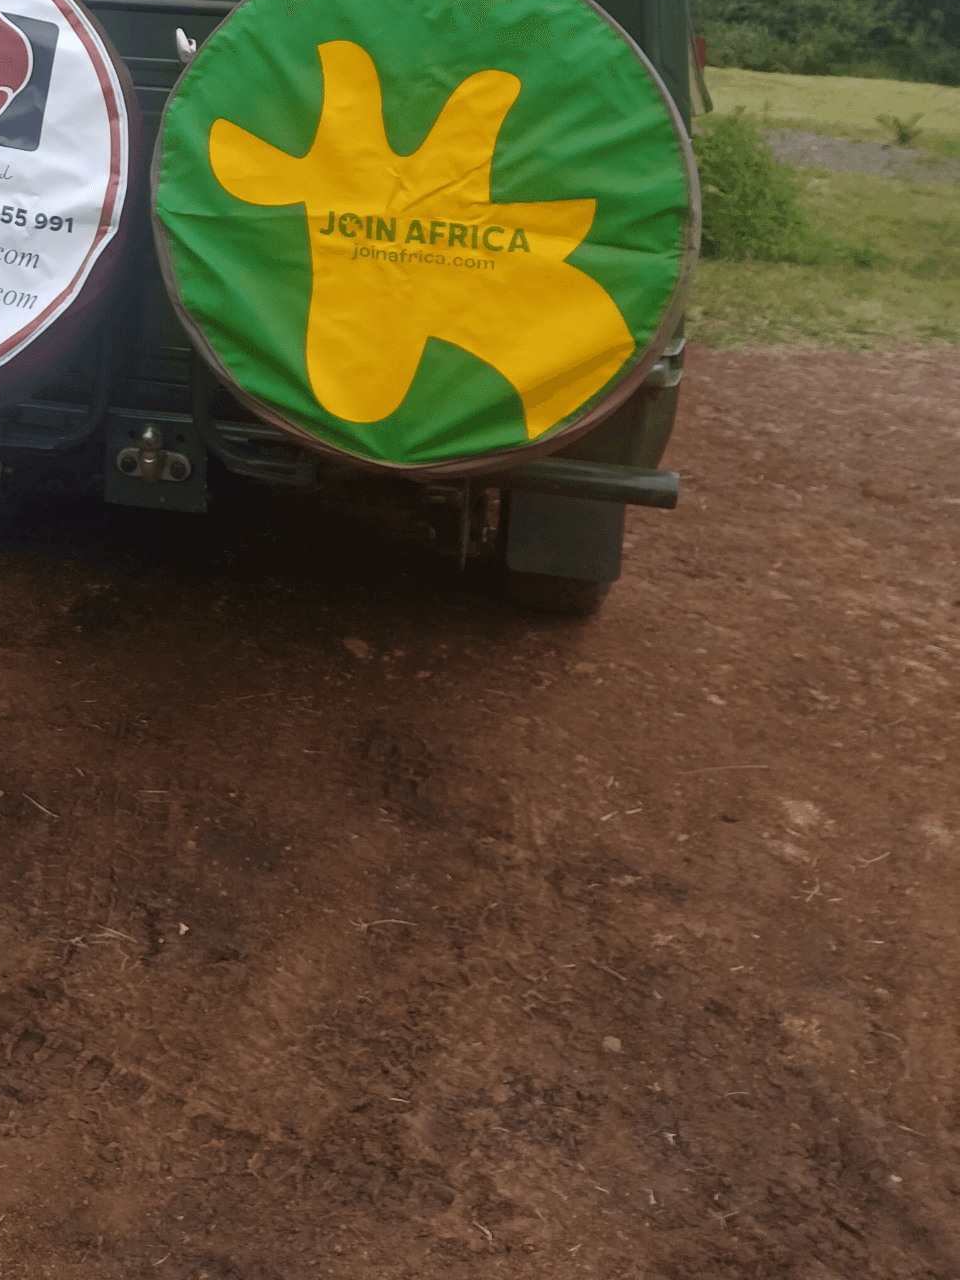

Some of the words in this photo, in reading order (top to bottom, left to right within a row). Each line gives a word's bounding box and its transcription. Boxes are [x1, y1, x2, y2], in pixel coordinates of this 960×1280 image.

[34, 212, 74, 234] 991
[319, 210, 397, 243] JOIN
[404, 219, 531, 253] AFRICA
[351, 243, 495, 270] joinafrica.com
